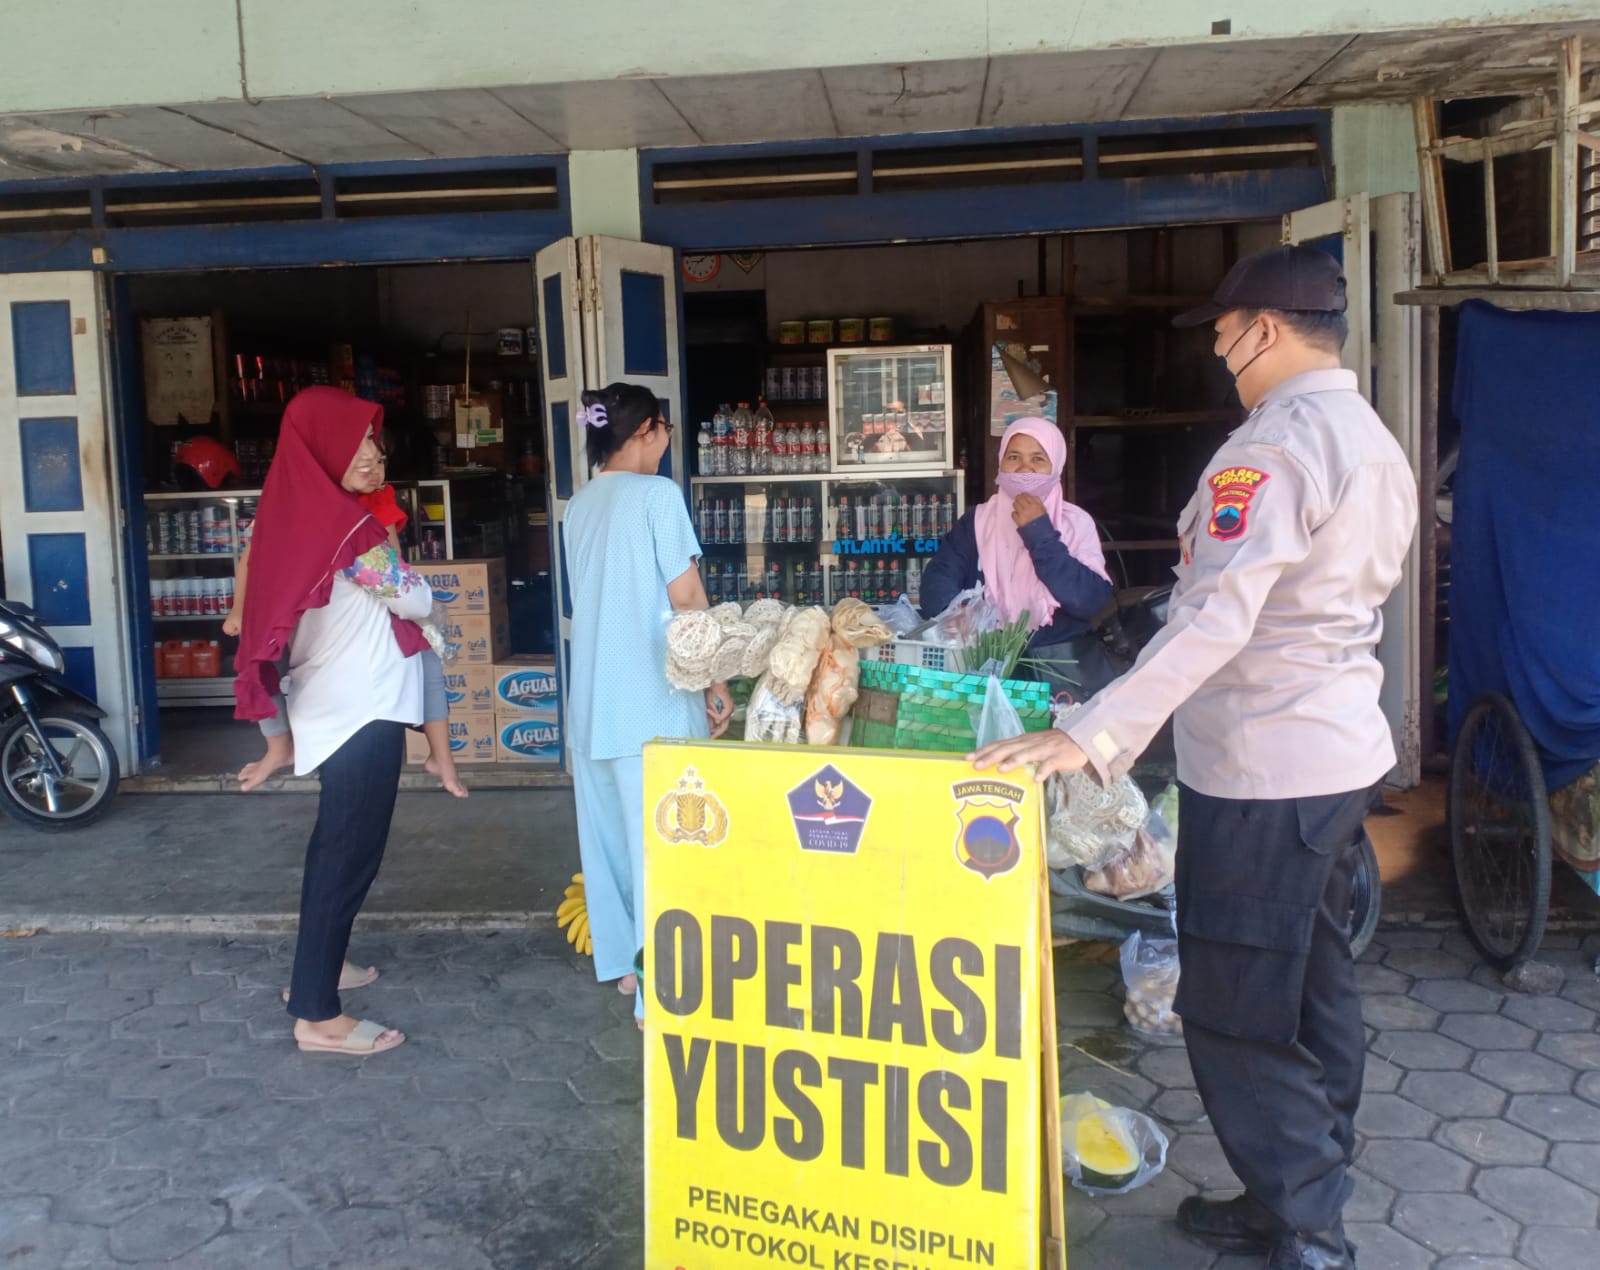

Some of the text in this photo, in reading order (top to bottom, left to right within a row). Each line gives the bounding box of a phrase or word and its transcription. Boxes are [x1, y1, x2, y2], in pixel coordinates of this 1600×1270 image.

[957, 784, 1021, 800] JAWA TENGAH
[653, 908, 1021, 1060] OPERASI
[661, 1033, 1008, 1195] YUSTISI
[675, 1217, 825, 1269] PROTOKOL
[688, 1186, 995, 1266] PENEGAKAN DISIPLIN
